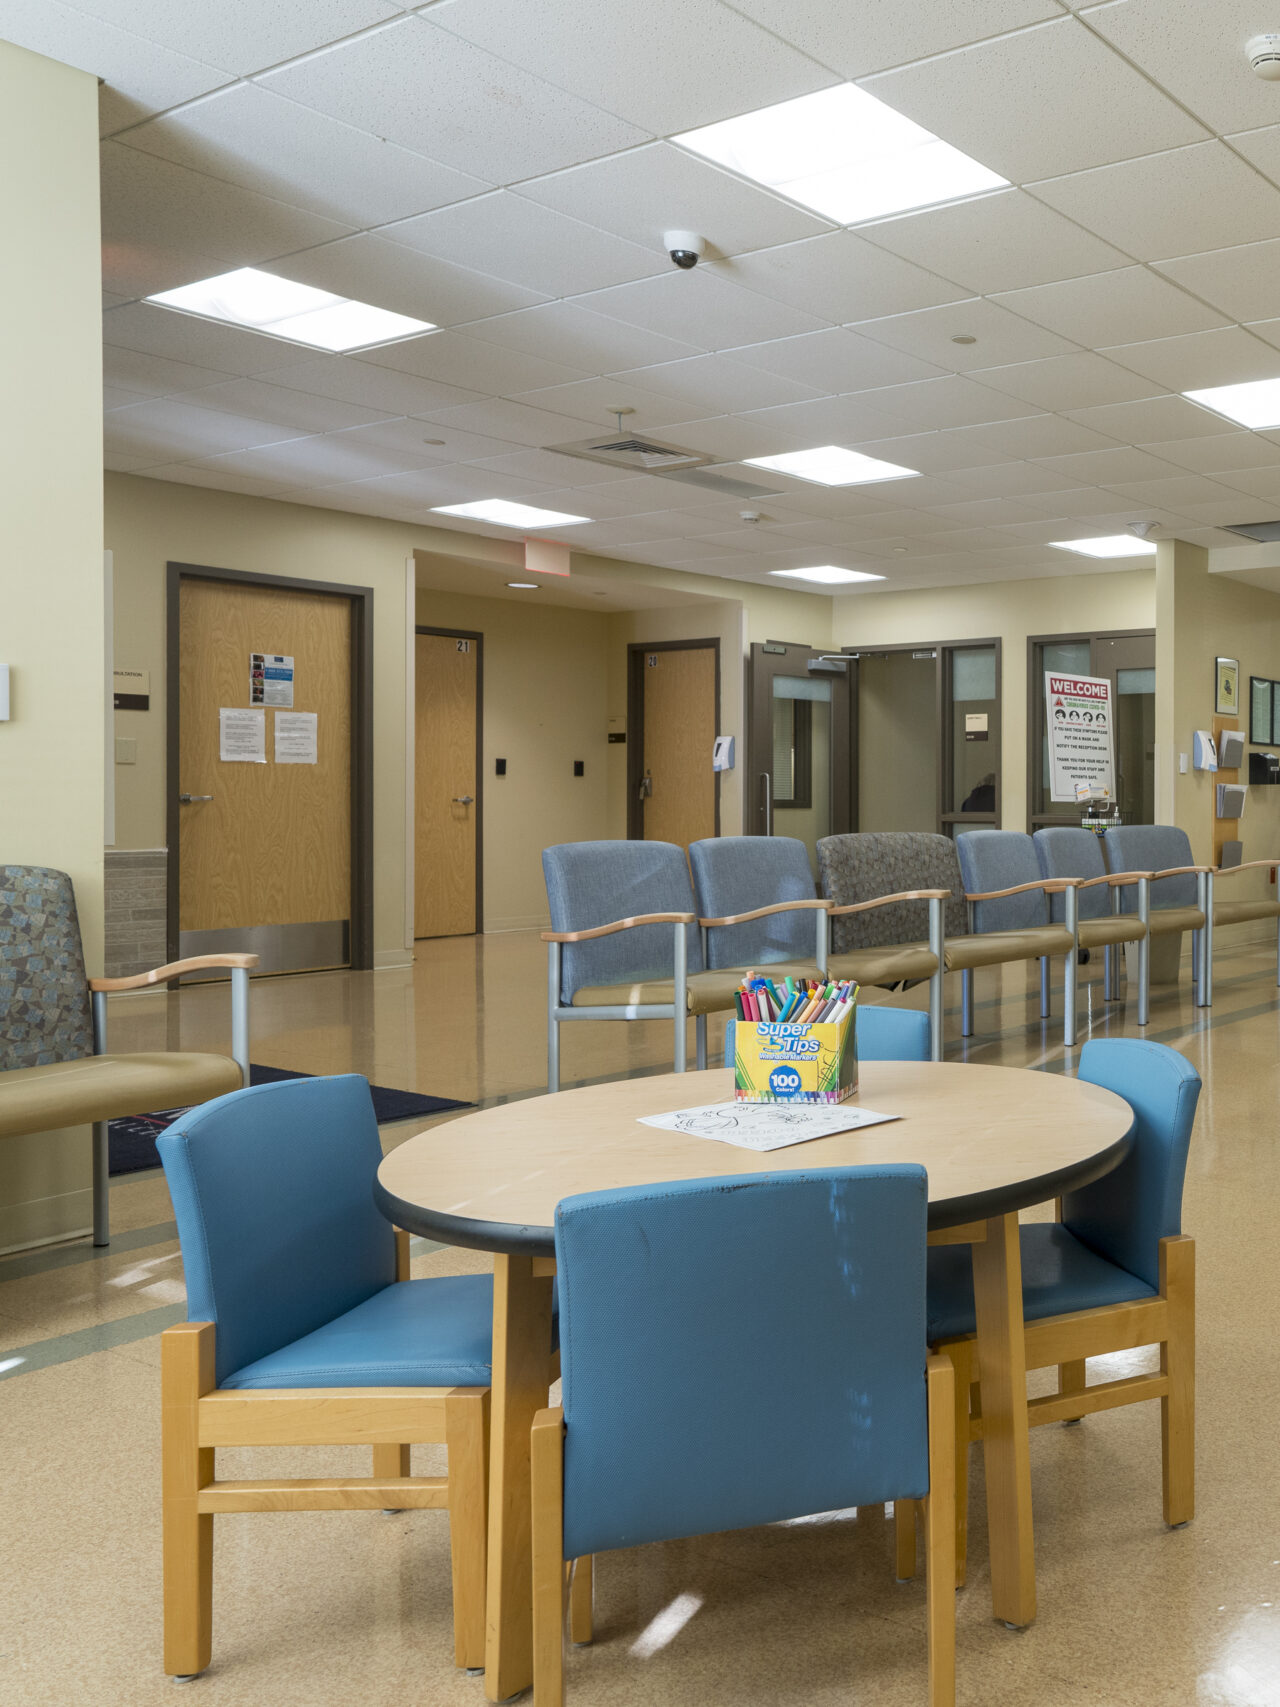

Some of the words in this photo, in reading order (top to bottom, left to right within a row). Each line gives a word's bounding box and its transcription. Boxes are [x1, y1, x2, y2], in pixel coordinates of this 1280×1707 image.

[457, 640, 468, 653] 21
[1051, 680, 1107, 697] WELCOME
[757, 1022, 812, 1038] Super
[783, 1037, 820, 1054] Tips
[771, 1074, 799, 1087] 100
